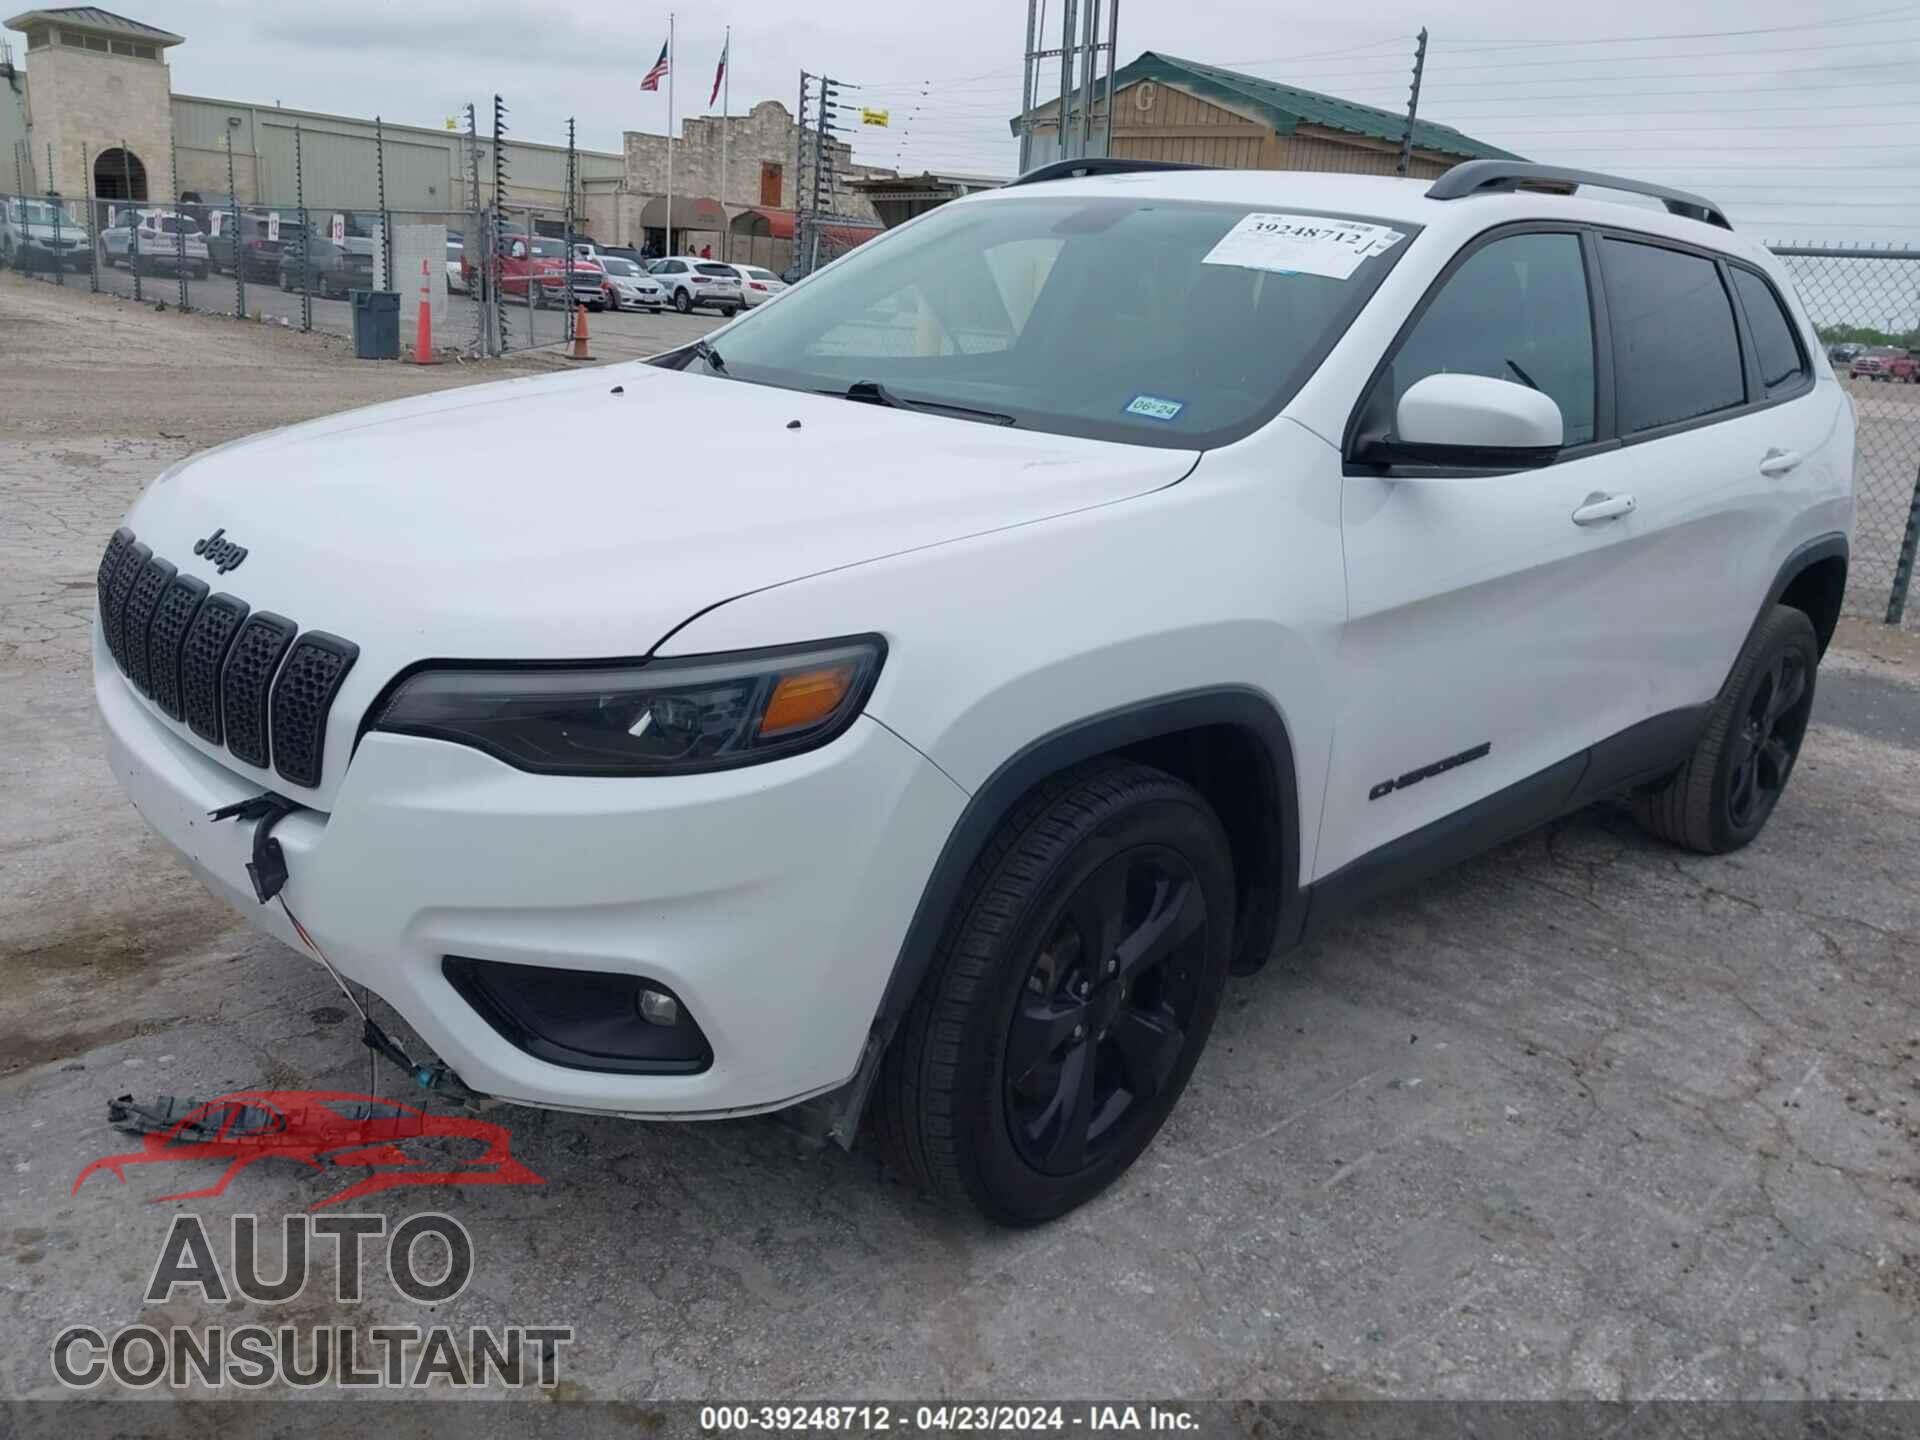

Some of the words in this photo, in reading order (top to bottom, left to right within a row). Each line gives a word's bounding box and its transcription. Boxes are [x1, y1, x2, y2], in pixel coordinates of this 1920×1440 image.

[1136, 82, 1154, 111] G
[335, 222, 343, 240] 13
[1247, 222, 1362, 245] 39248712
[193, 528, 249, 576] Jeep
